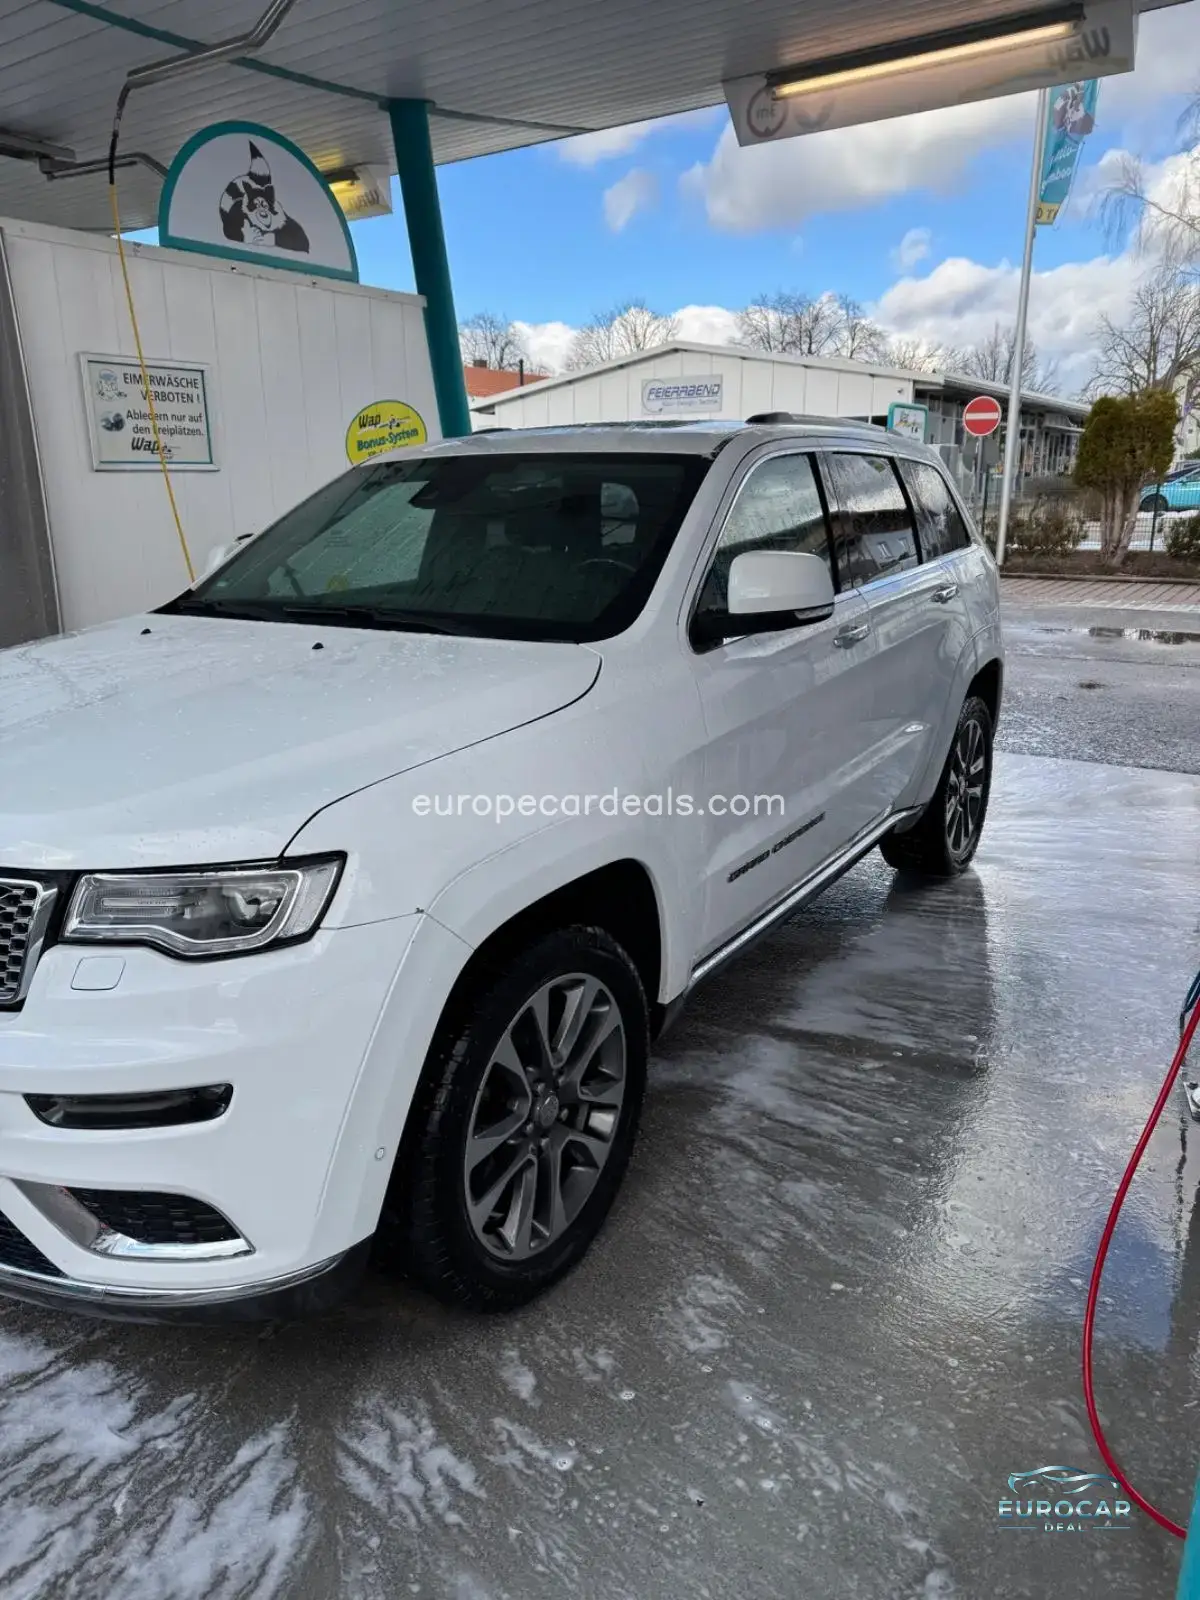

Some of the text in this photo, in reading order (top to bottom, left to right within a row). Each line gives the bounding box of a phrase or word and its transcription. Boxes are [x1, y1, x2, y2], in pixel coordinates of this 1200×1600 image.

[123, 372, 200, 389] EIMRWÄSCHE
[647, 383, 720, 400] FEIERABEND
[171, 413, 186, 422] nur
[188, 412, 203, 423] auf
[358, 413, 381, 429] Wap
[132, 424, 204, 437] den reiplätzen.
[131, 436, 160, 454] Wap
[356, 428, 419, 452] Bonus-System
